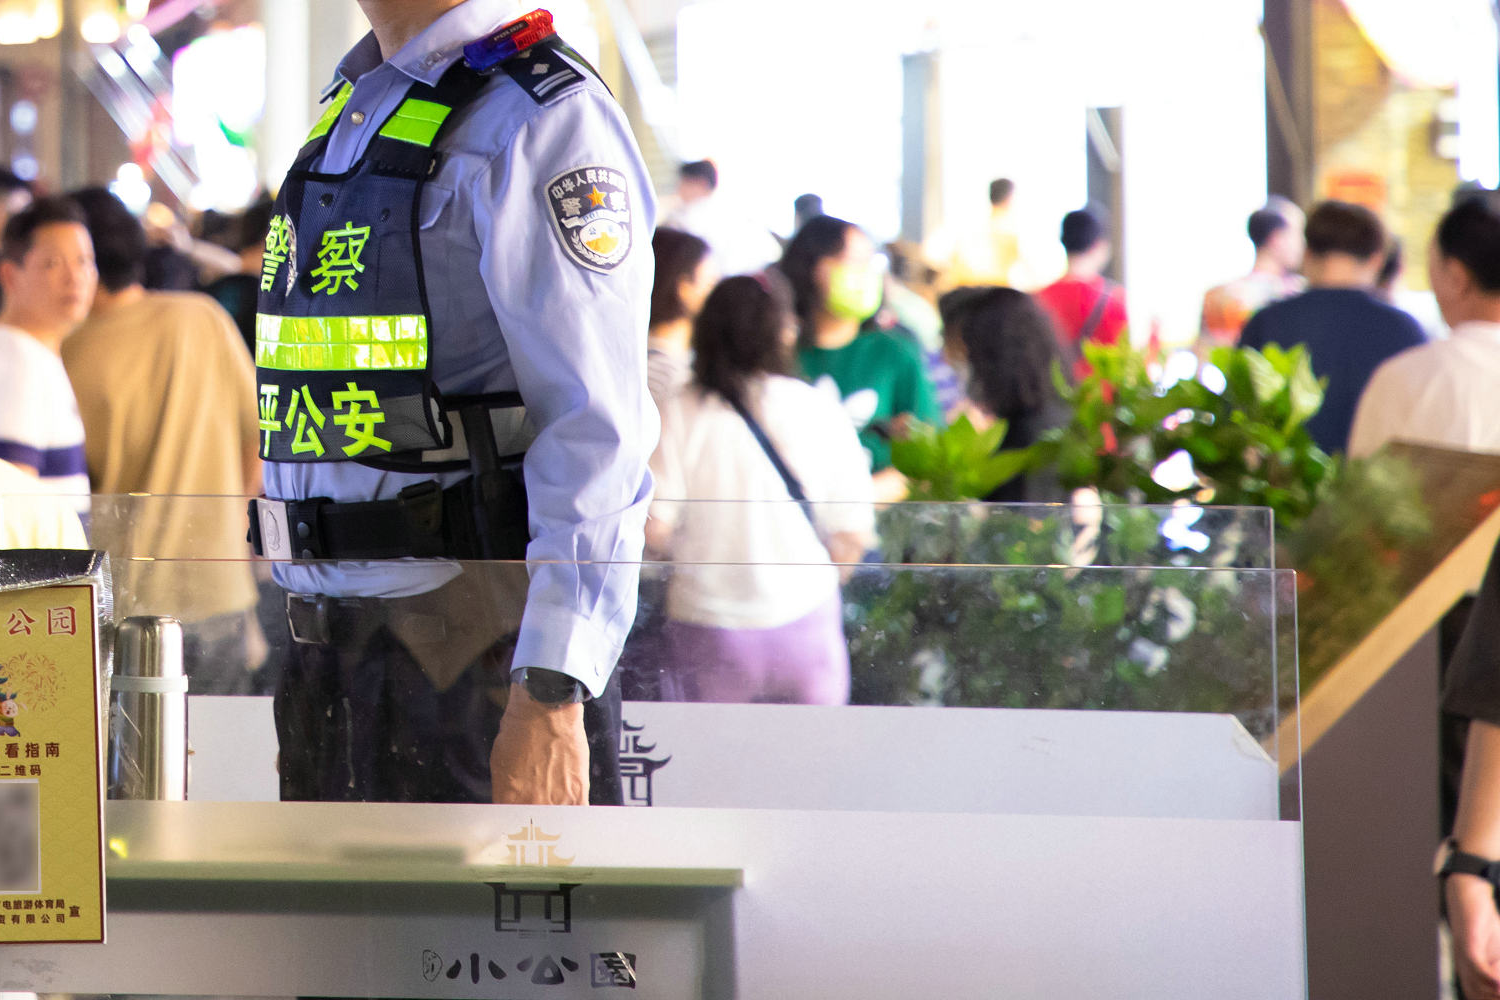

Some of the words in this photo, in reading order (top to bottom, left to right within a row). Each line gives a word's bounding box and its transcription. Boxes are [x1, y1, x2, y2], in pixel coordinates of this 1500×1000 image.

[551, 169, 627, 200] 中华人民共
